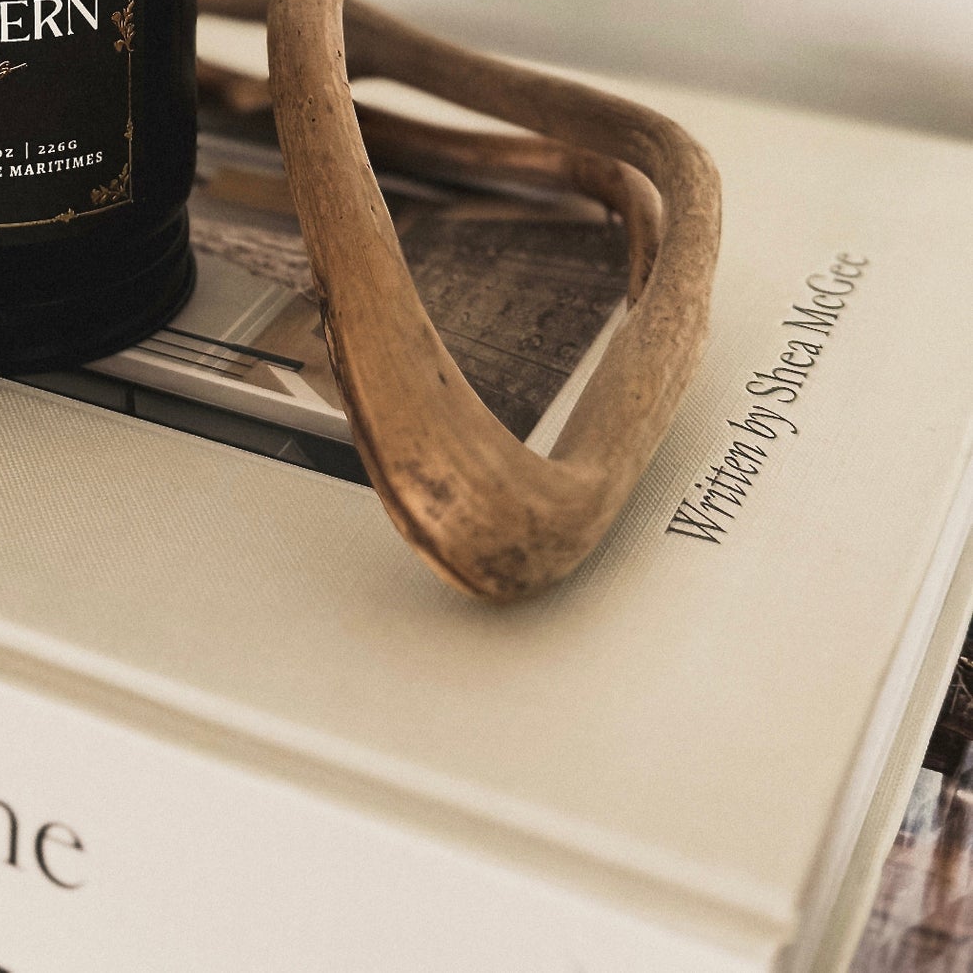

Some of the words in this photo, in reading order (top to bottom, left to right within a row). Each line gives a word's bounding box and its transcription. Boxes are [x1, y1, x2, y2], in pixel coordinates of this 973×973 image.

[9, 151, 104, 178] MARITIMES
[38, 139, 78, 155] 226G
[781, 252, 869, 337] McGee
[745, 338, 823, 404] Shea
[726, 405, 798, 439] by
[664, 440, 769, 545] Written
